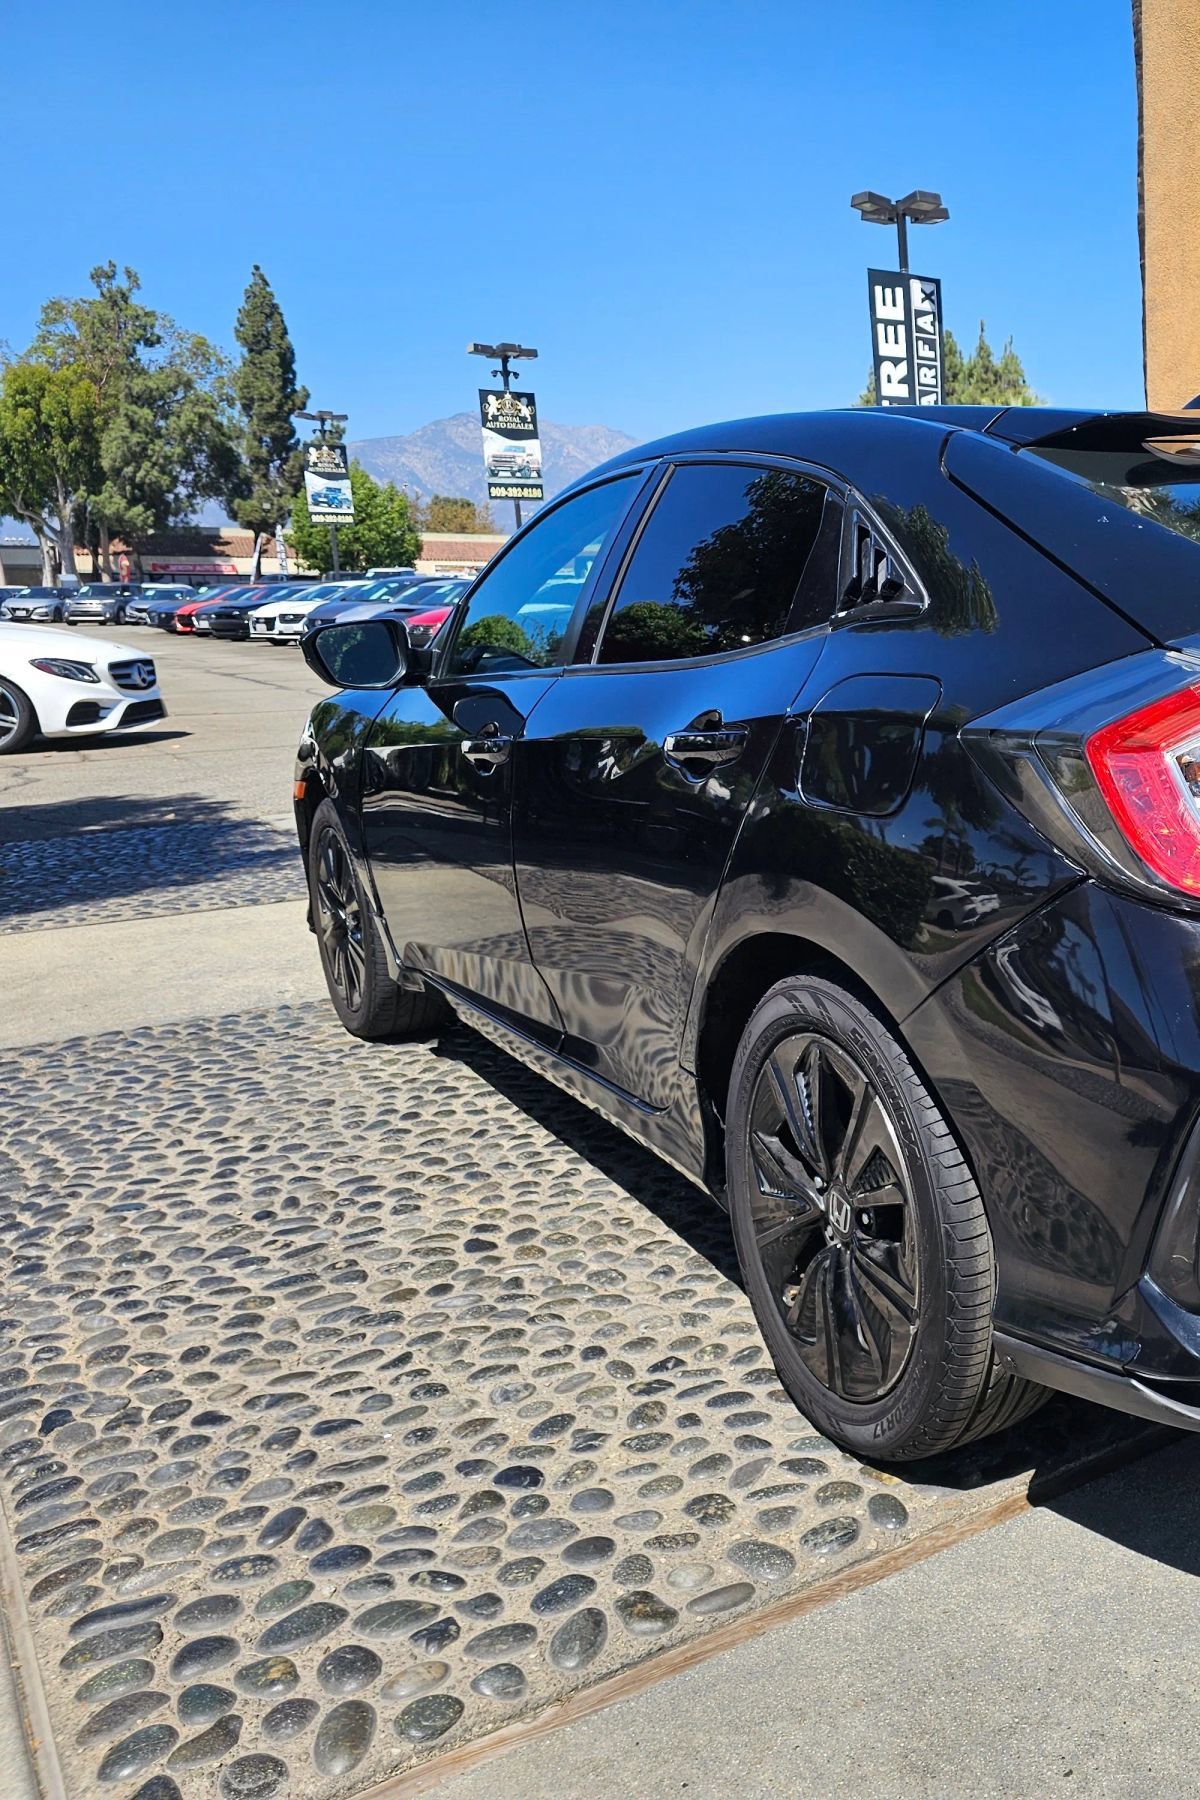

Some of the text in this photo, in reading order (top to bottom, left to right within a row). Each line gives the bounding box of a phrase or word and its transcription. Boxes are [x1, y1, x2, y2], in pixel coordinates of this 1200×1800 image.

[874, 284, 910, 405] REE
[915, 287, 938, 405] ARFAX
[486, 421, 534, 430] AUTO DEALER
